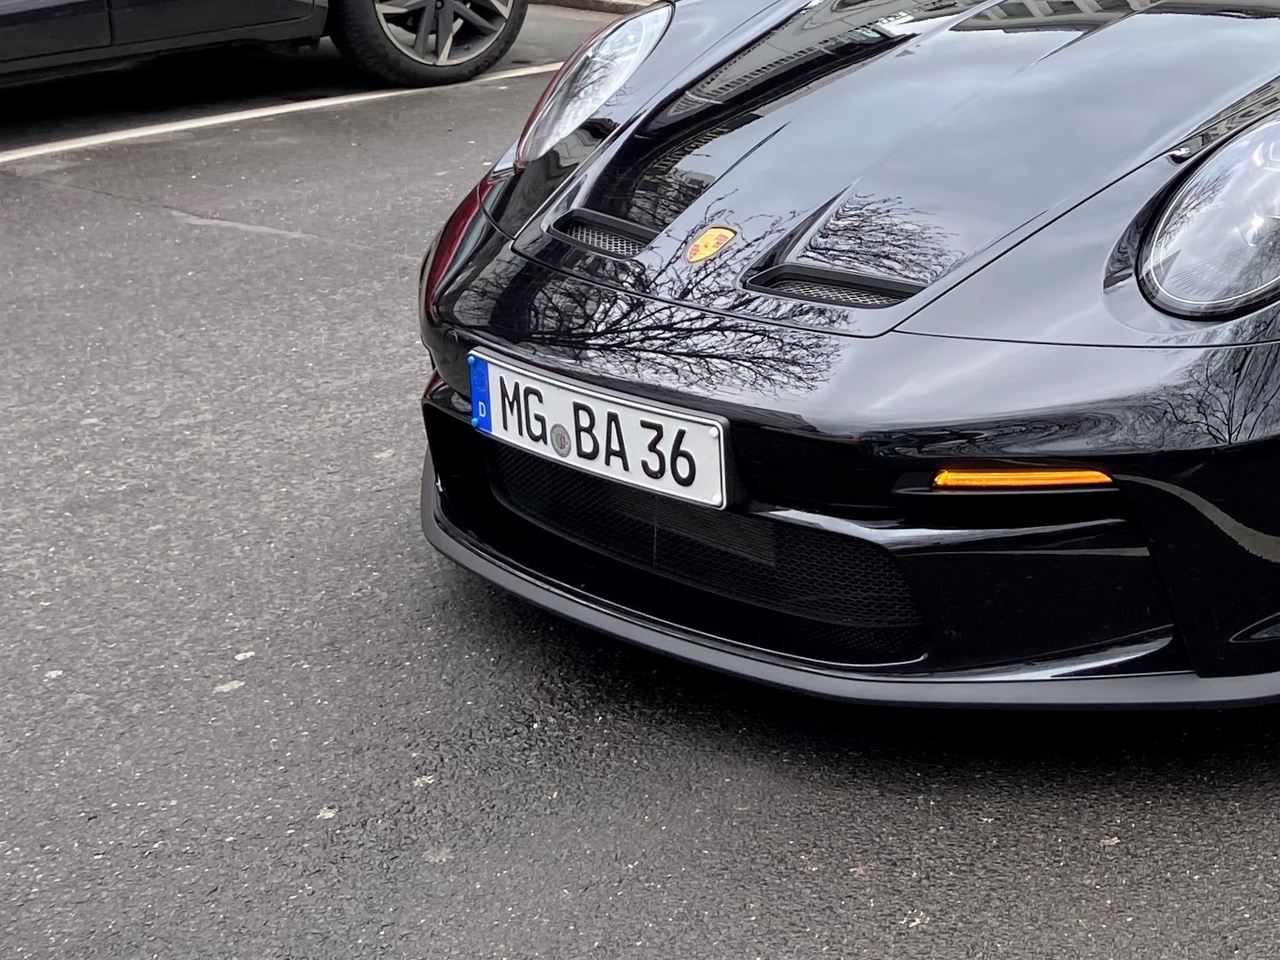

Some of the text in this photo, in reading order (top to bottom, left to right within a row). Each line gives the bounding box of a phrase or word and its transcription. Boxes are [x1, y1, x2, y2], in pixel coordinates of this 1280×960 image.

[478, 401, 487, 418] D
[499, 375, 696, 487] MG BA 36
